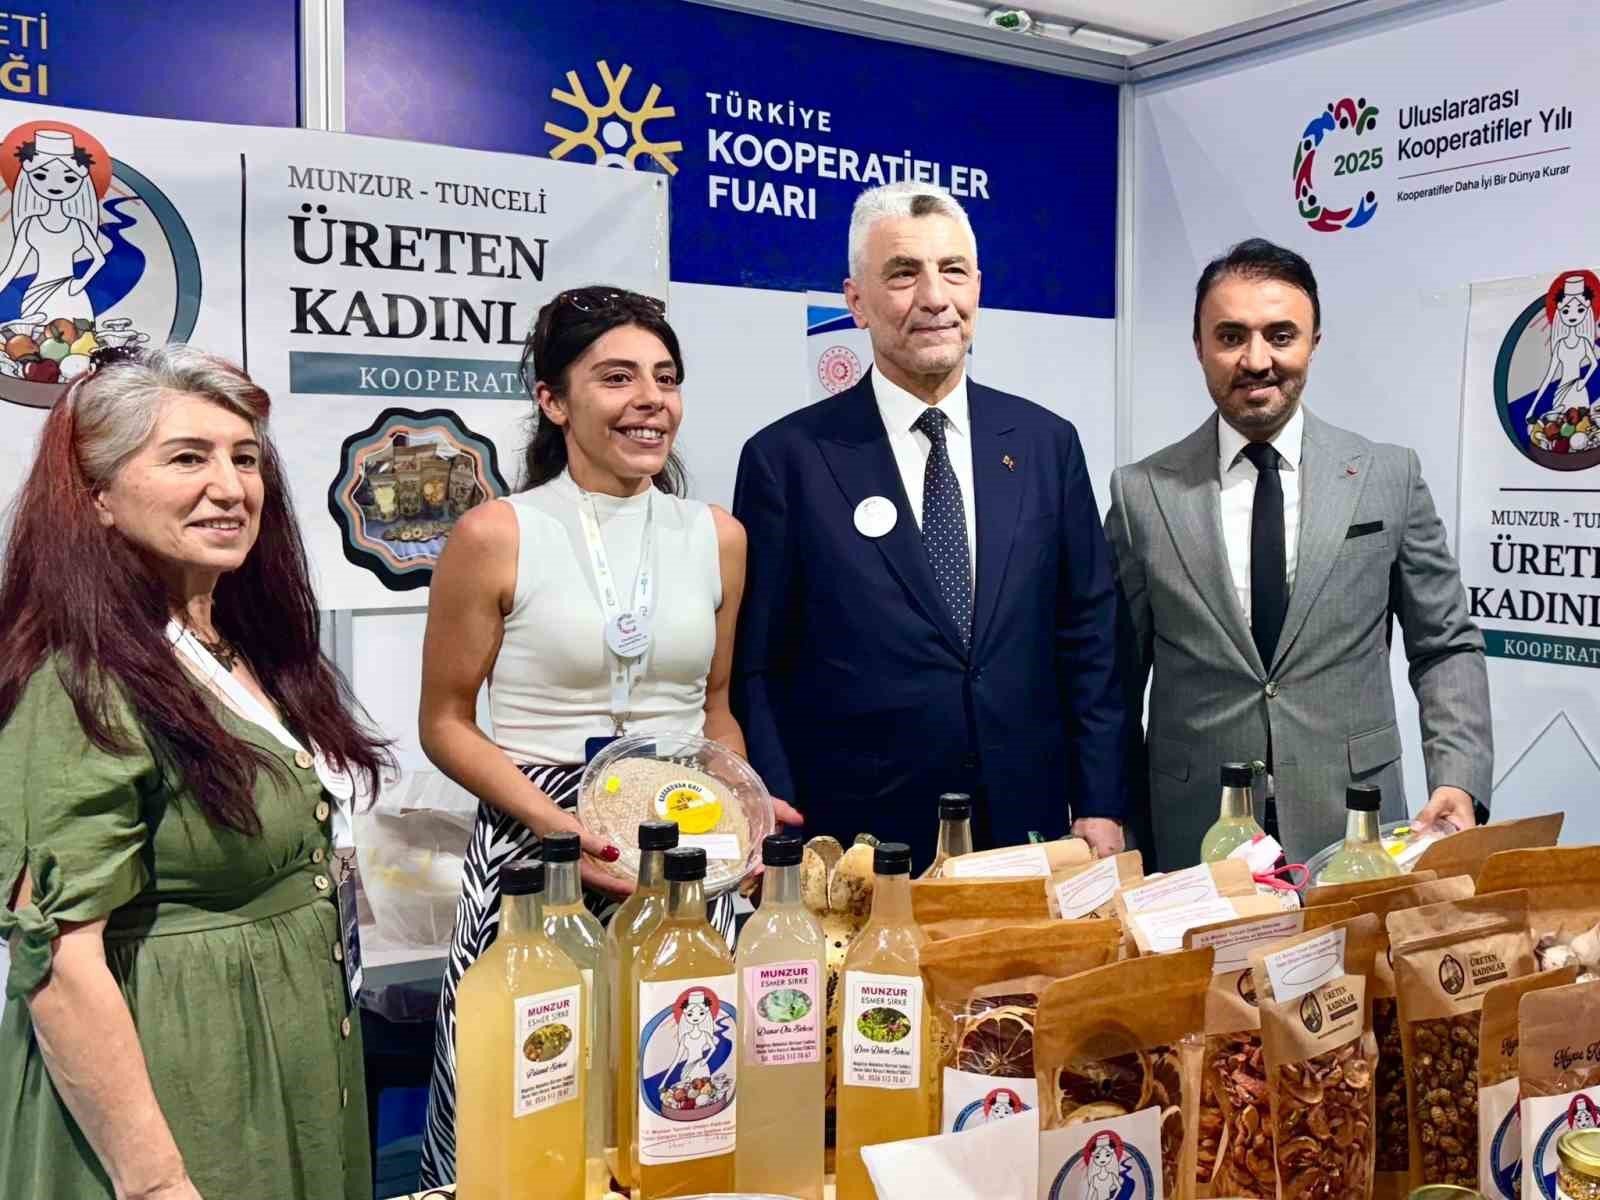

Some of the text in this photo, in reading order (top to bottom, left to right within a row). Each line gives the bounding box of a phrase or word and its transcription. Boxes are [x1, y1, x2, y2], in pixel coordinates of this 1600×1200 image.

[706, 91, 832, 132] TÜRKİYE
[1399, 89, 1519, 130] Uluslararası
[1398, 106, 1572, 161] Kooperatifler Yılı
[707, 129, 989, 199] KOOPERATİFLER
[1334, 147, 1383, 177] 2025
[288, 165, 413, 200] MUNZUR
[435, 182, 547, 214] TUNCELİ
[708, 174, 817, 219] FUARI
[1397, 164, 1570, 203] Kooperatifler Daha İyi Bir Dünya Kurar
[288, 203, 549, 281] ÜRETEN
[289, 287, 528, 345] KADINL
[1491, 510, 1560, 527] MUNZUR
[1573, 512, 1600, 528] TU
[760, 967, 809, 978] MUNZUR
[861, 986, 908, 997] MUNZUR
[527, 1000, 570, 1017] MUNZUR
[861, 997, 885, 1005] ESMER
